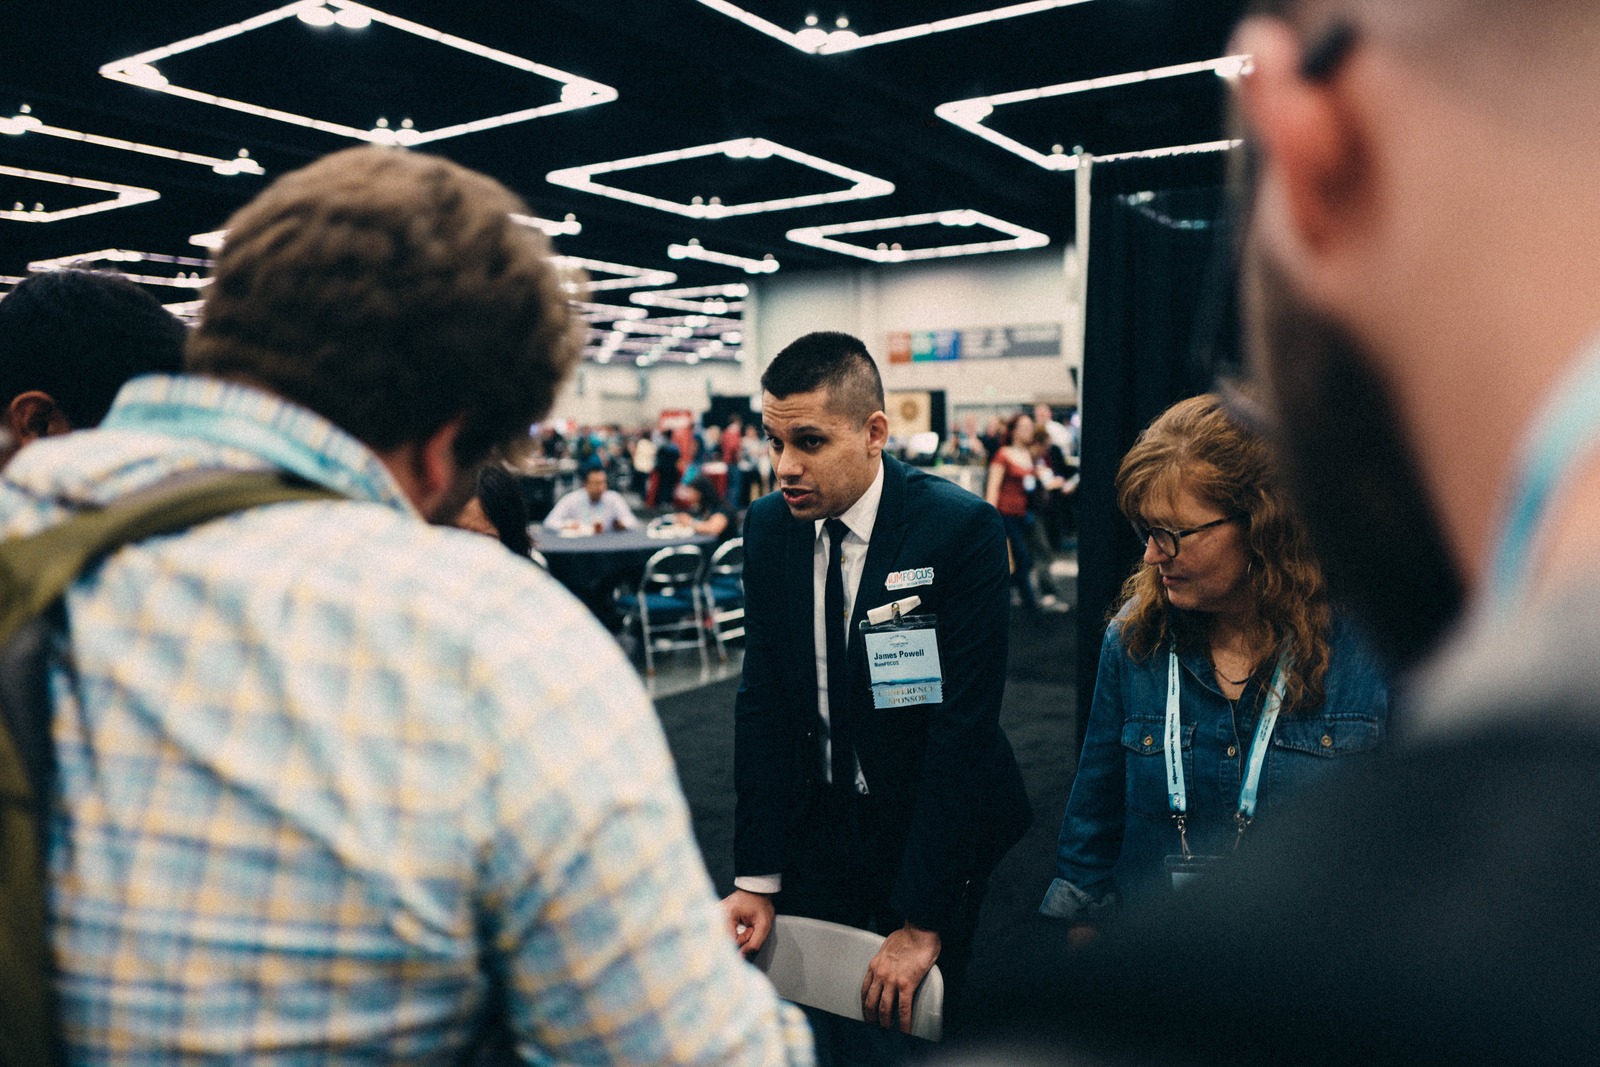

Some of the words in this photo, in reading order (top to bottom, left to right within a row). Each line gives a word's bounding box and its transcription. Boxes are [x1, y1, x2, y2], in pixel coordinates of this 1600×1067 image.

[874, 652, 897, 660] James
[899, 649, 925, 658] Powell
[878, 685, 935, 697] CONFERENCE
[889, 695, 927, 704] SPONSOR
